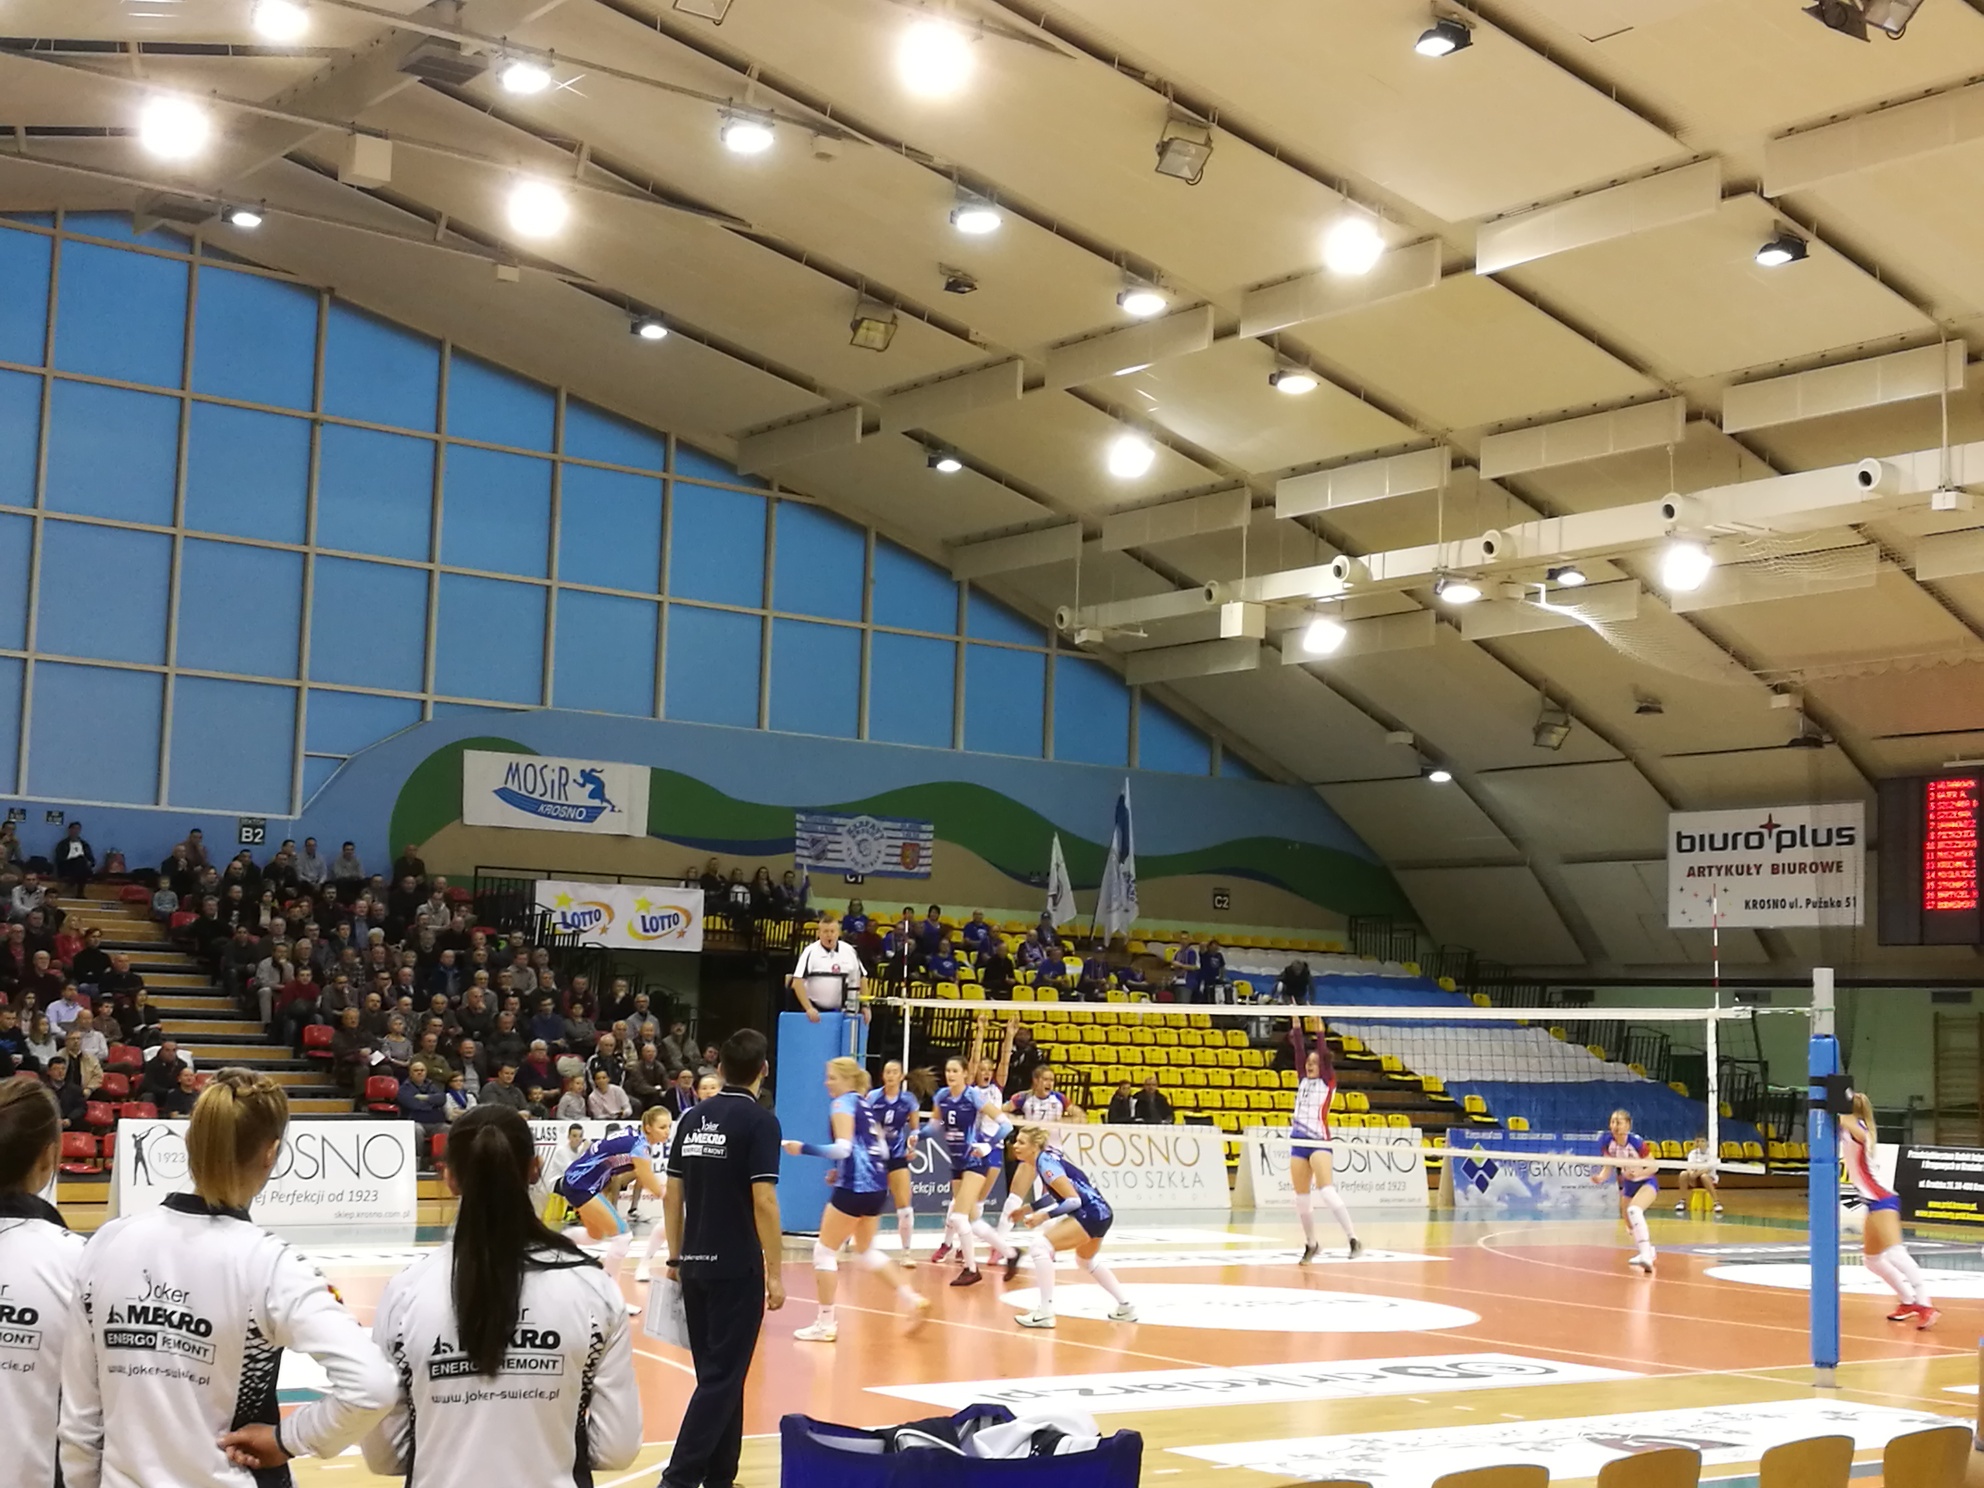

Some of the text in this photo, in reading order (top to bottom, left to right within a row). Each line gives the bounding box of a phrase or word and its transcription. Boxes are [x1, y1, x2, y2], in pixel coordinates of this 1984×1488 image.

[504, 762, 570, 801] MOSiR
[537, 804, 586, 820] KROSNO
[241, 827, 264, 843] B2
[1676, 824, 1856, 854] biuro plus
[1686, 861, 1844, 878] ARTYKUŁY BIUROWE
[1214, 895, 1229, 909] C2
[1744, 899, 1787, 910] KROSNO
[1789, 898, 1802, 909] ul.
[561, 908, 680, 933] LOTTO LOTTO
[948, 1110, 956, 1125] 6
[1061, 1131, 1200, 1167] KROSNO
[157, 1152, 187, 1164] 1923
[1089, 1170, 1205, 1189] ASTO SZKŁA
[270, 1190, 325, 1205] Perfekcji
[328, 1190, 344, 1203] od
[349, 1190, 379, 1202] 1923
[127, 1305, 213, 1338] MEKRO
[107, 1333, 210, 1358] ENERGO REMONT
[431, 1361, 480, 1377] ENER
[431, 1388, 560, 1404] www.joker-swiecie.pl
